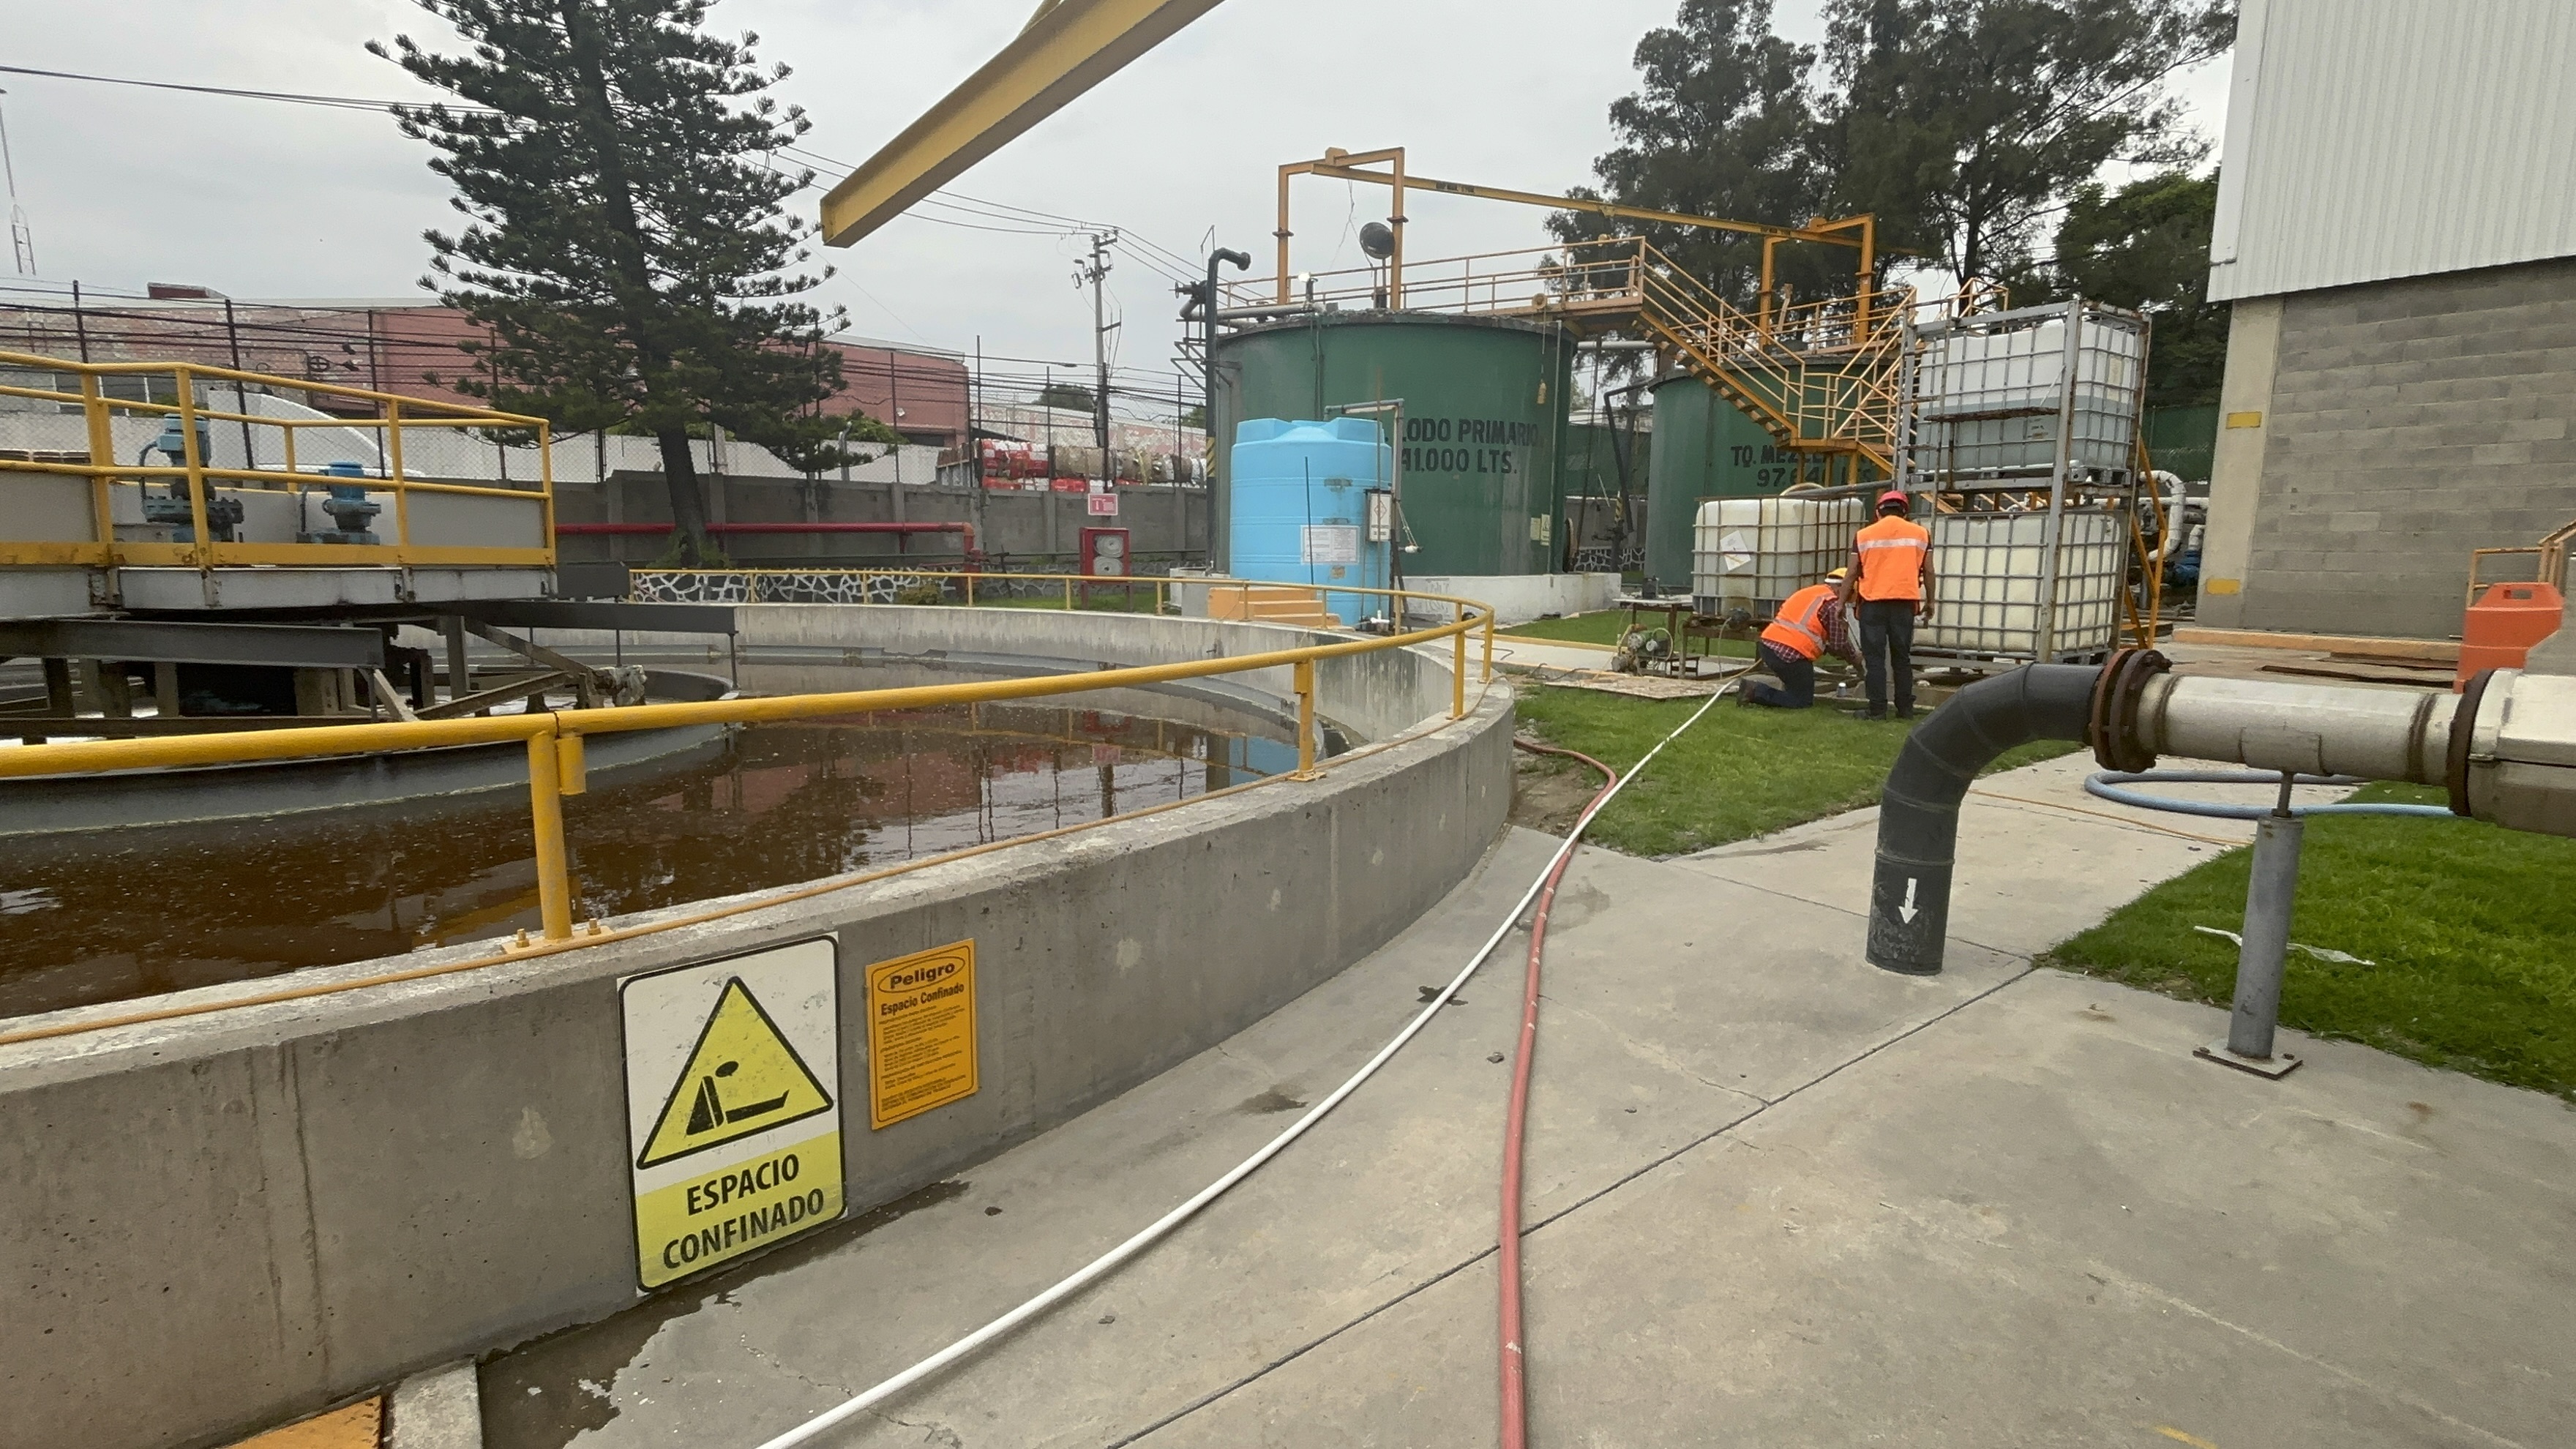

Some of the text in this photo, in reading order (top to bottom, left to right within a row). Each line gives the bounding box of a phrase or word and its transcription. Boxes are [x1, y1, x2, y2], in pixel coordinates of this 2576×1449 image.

[1403, 418, 1451, 443] ODO
[1478, 448, 1517, 474] LTS.
[890, 962, 956, 990] Peligro
[880, 982, 965, 1016] Espacio Confinado
[687, 1153, 800, 1216] ESPACIO
[663, 1187, 824, 1270] CONFINADO
